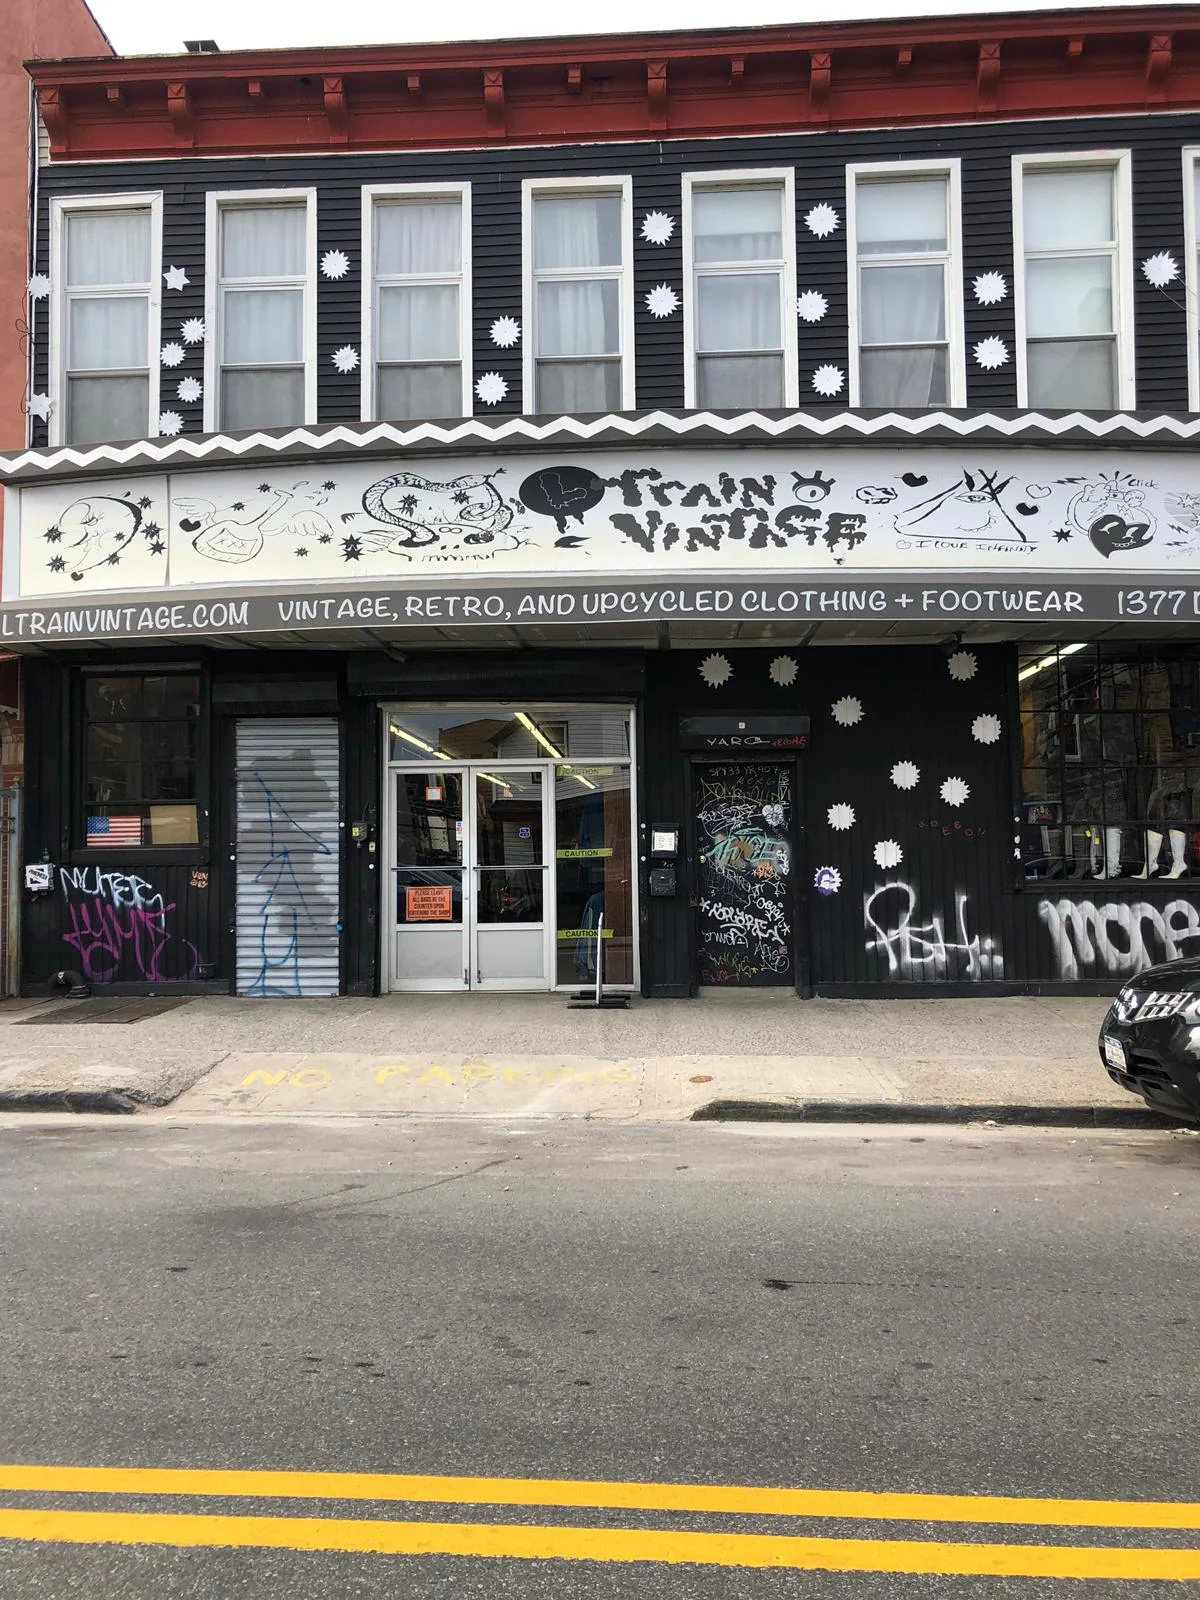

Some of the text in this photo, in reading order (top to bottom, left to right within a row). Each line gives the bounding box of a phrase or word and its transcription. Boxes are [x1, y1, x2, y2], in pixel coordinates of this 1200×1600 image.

[278, 589, 1085, 622] VINTAGE, RETRO, AND UPCYCLED CLOTHING + FOOTWEAR
[1117, 590, 1187, 616] 1377
[1, 601, 249, 636] LTRAINVINTAGE.COM
[565, 768, 599, 776] CAUTION
[564, 850, 599, 858] CAUTION
[565, 930, 599, 938] CAUTION
[240, 1069, 333, 1087] NO
